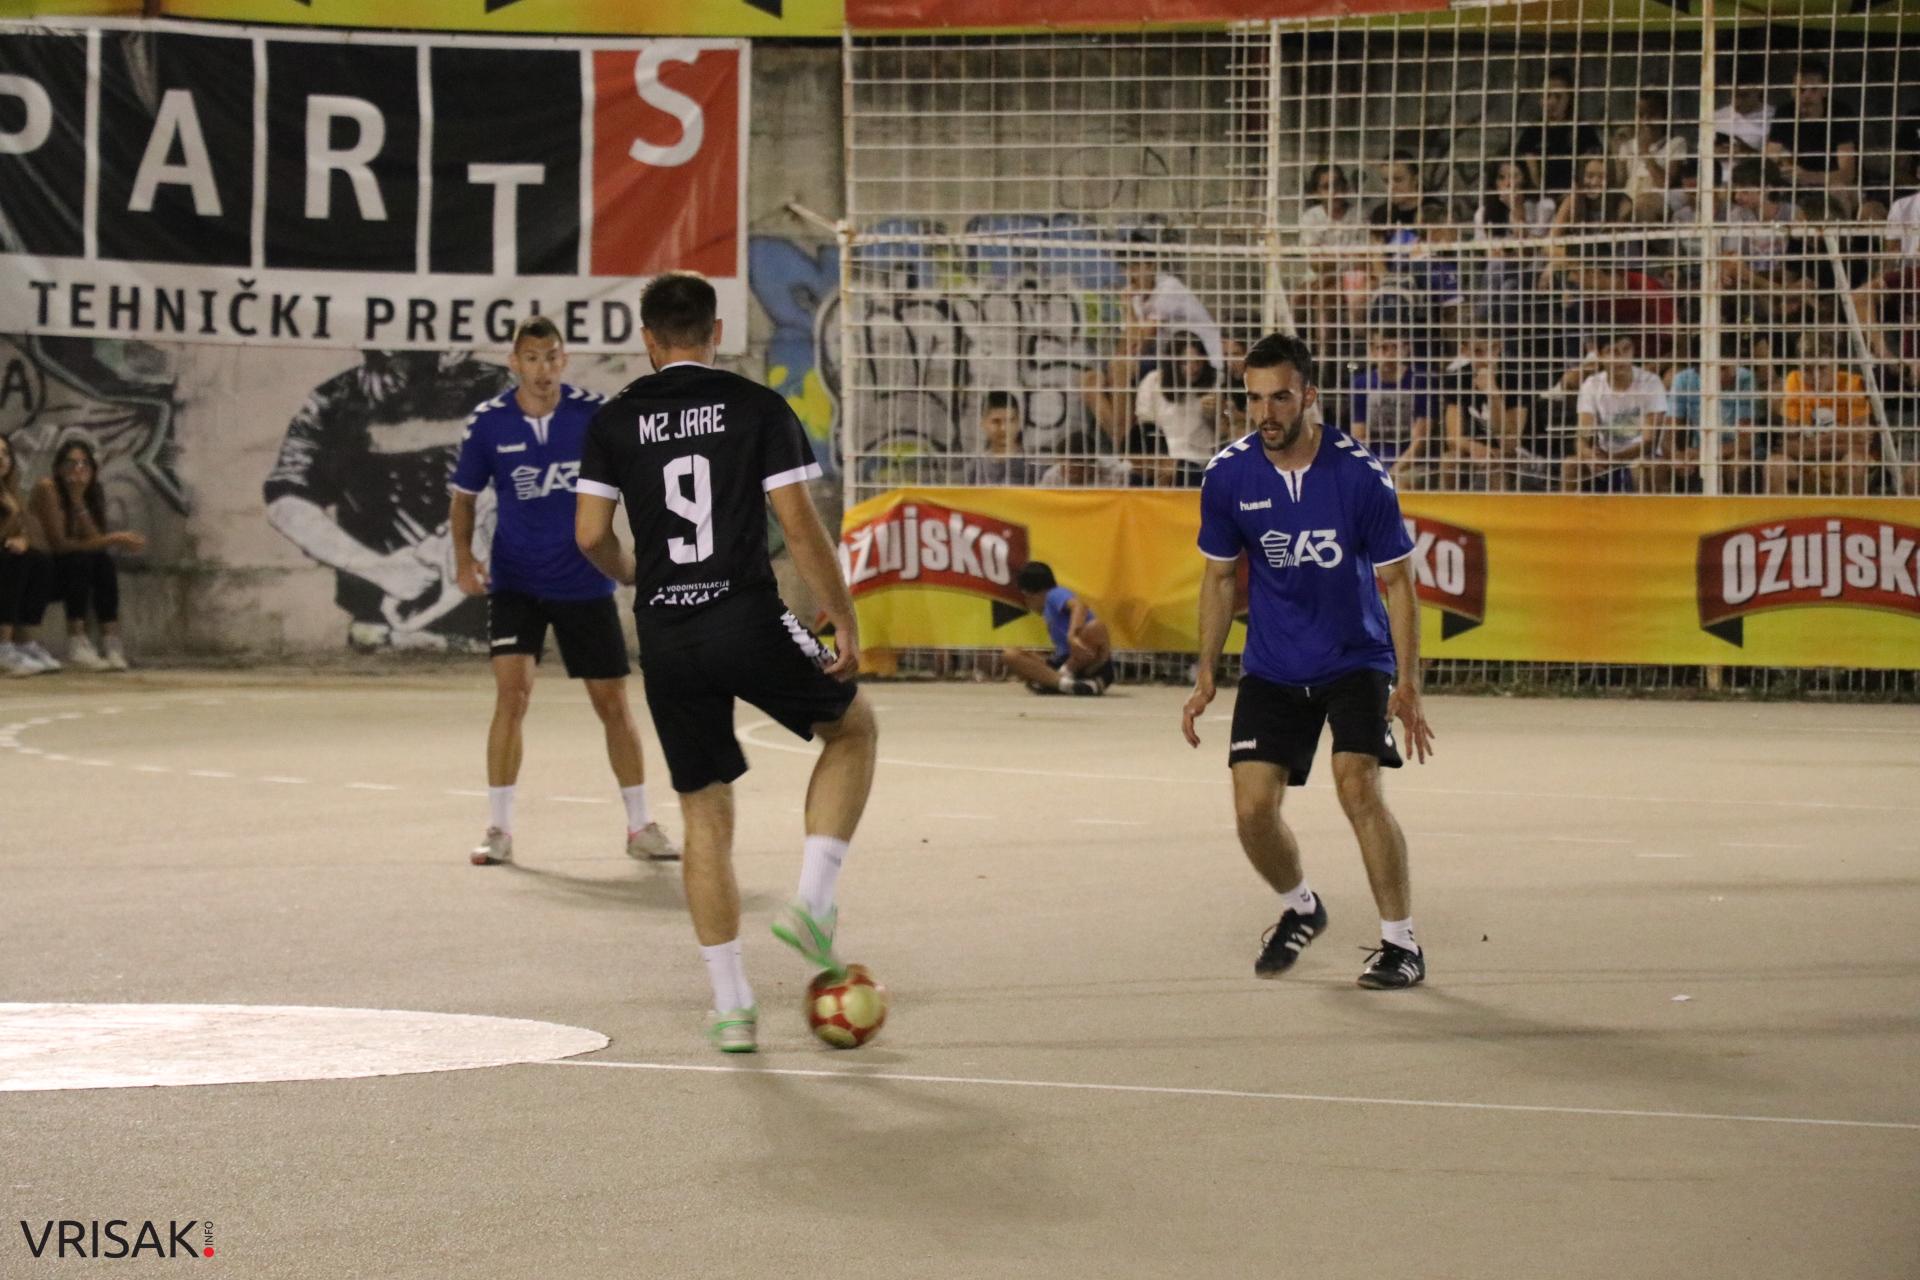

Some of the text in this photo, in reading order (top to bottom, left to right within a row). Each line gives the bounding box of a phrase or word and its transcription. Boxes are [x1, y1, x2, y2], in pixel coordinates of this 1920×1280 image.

[29, 278, 332, 339] TEHNIČKI
[674, 403, 726, 438] JARE
[662, 454, 714, 565] 9
[1722, 520, 1920, 605] Ožujsk
